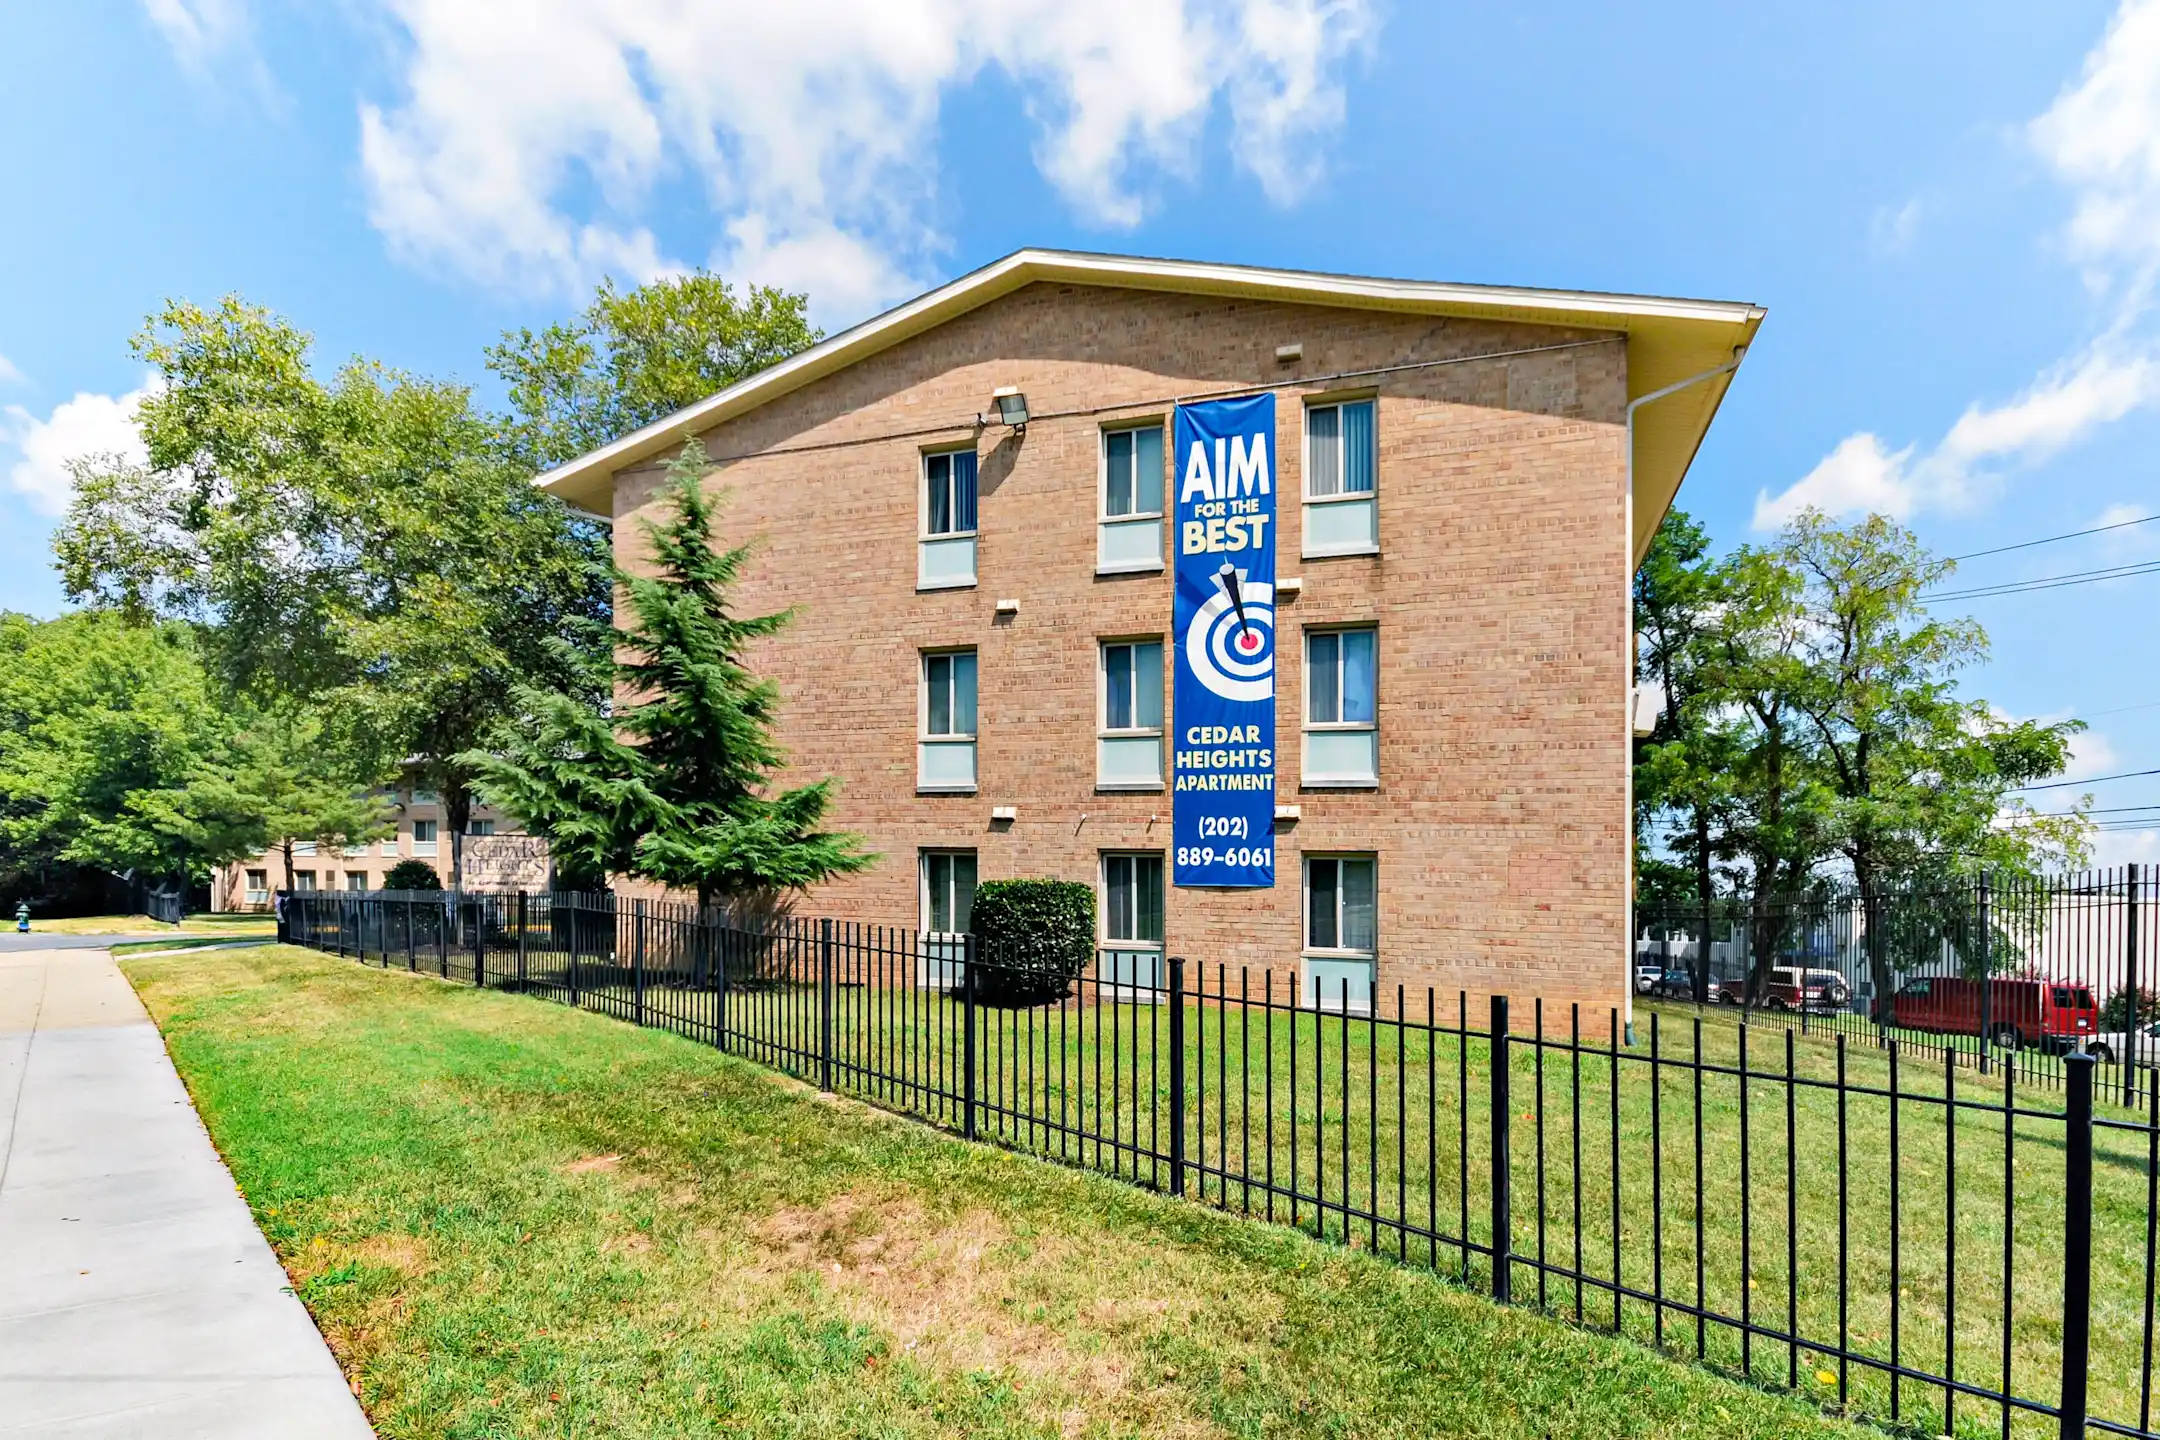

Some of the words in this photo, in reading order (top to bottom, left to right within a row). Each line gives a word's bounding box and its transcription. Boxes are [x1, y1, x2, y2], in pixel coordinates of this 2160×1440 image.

[1180, 432, 1271, 504] AIM
[1194, 501, 1227, 518] FOR
[1230, 498, 1260, 514] THE
[1182, 513, 1270, 556] BEST
[1186, 725, 1261, 745] CEDAR
[1176, 749, 1273, 769] HEIGHTS
[1175, 774, 1274, 792] APARTMENT
[1198, 815, 1249, 840] (202)
[472, 840, 538, 858] CEDAR
[1176, 846, 1272, 867] 889-6061
[467, 858, 545, 876] HEIGHTS
